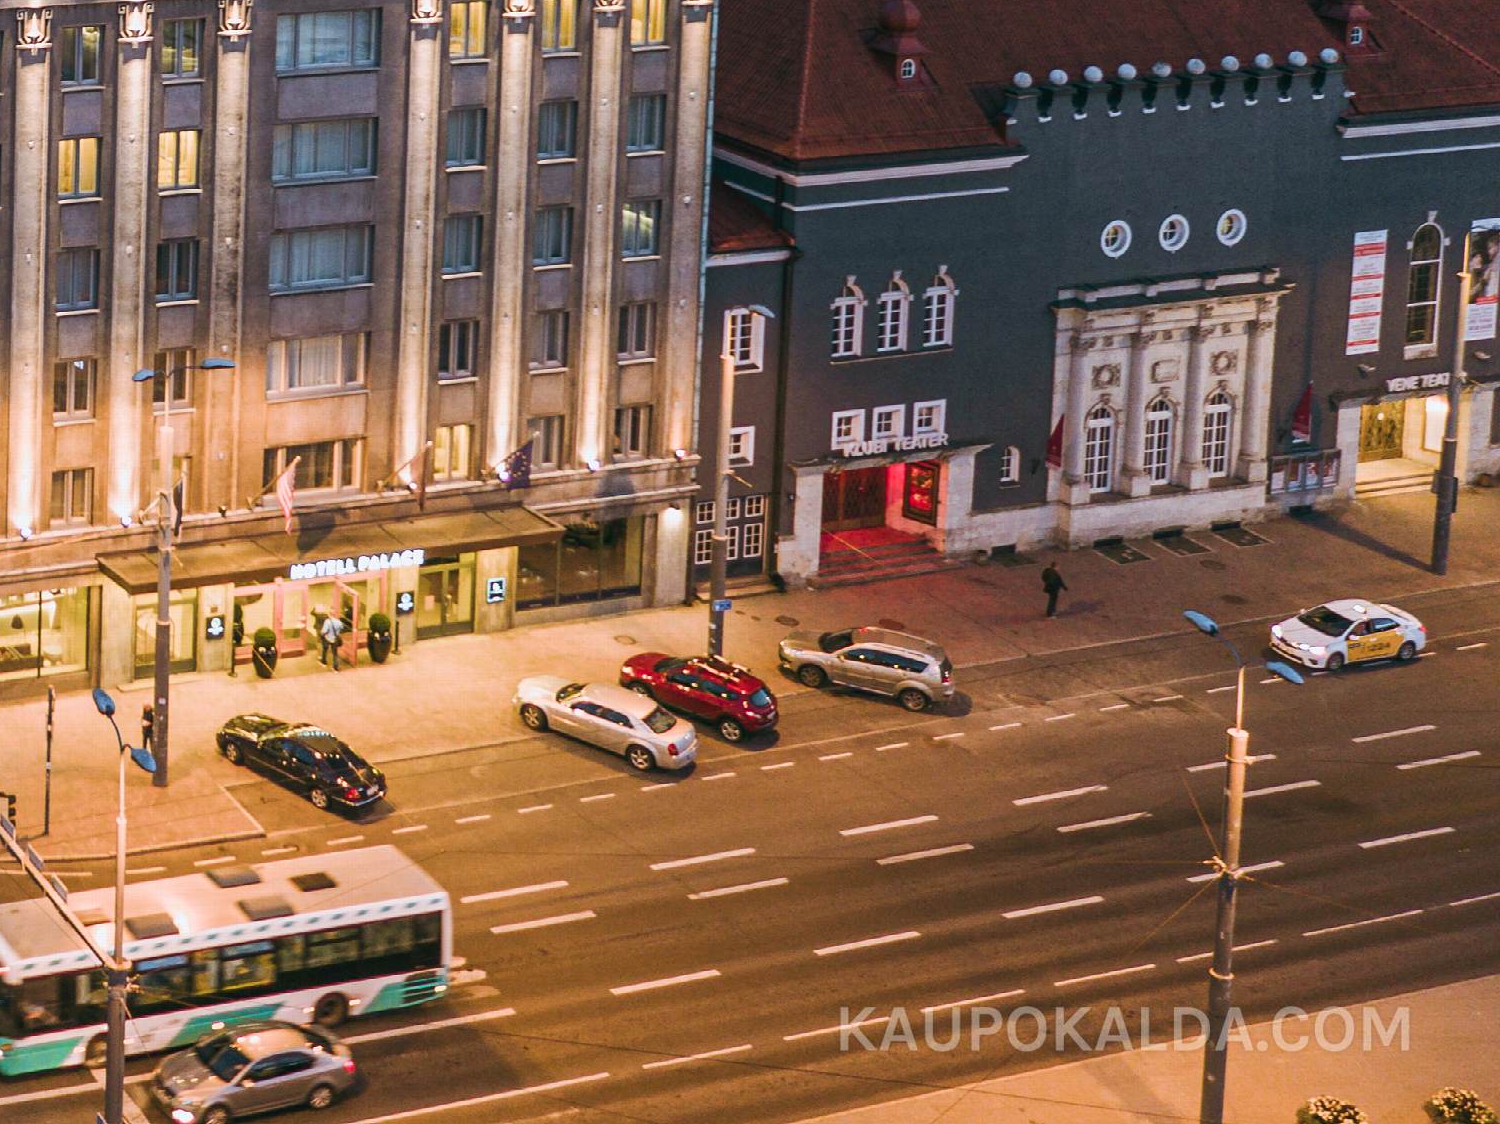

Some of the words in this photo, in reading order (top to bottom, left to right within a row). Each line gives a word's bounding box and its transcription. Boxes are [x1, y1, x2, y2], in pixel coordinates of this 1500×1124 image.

[1386, 376, 1419, 392] VENE
[1420, 372, 1450, 387] TEAT
[843, 440, 887, 458] KLUBI
[894, 434, 949, 452] TEATER
[290, 559, 356, 580] HOTELL
[358, 549, 425, 571] PALACE
